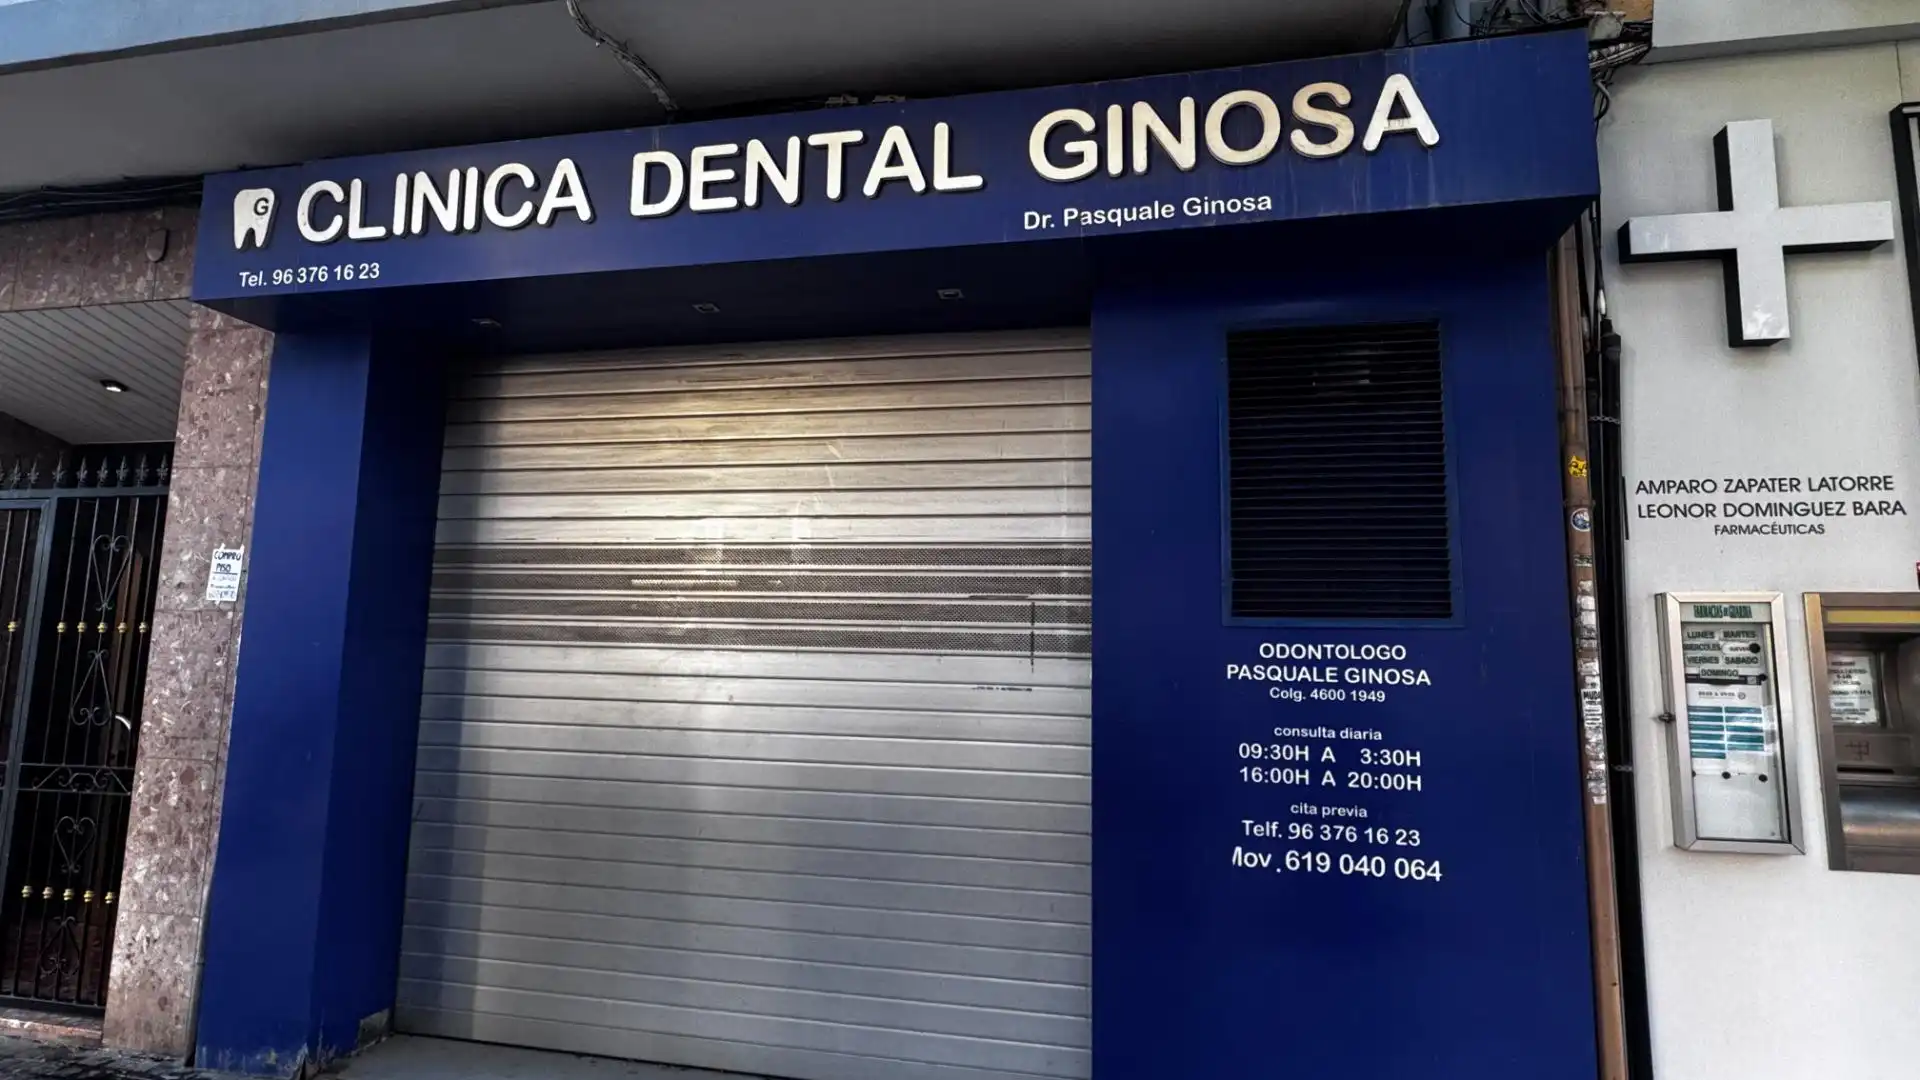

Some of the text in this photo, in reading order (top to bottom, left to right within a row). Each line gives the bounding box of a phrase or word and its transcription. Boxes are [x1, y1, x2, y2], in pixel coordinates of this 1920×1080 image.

[297, 74, 1439, 241] CLINICA DENTAL GINOSA
[253, 198, 269, 216] G
[1025, 196, 1271, 229] Dr. Pasquale Ginosa
[240, 263, 379, 287] Tel. 96 376 16 23
[1636, 476, 1893, 494] AMPARO ZAPATER LATORRE
[1638, 501, 1907, 518] LEONOR DOMINGUEZ BARA
[1715, 522, 1825, 535] FARMACÉUTICAS
[1260, 643, 1406, 660] ODONTOLOGO
[1228, 665, 1431, 685] PASQUALE GINOSA
[1270, 687, 1385, 702] Colg. 4600 1949
[1274, 727, 1382, 740] consulta diaria
[1239, 743, 1420, 766] 09:30H A 3:30H
[1240, 767, 1421, 791] 16:00H A 20:00H
[1291, 803, 1367, 818] cita previa
[1242, 820, 1420, 846] Telf. 96 376 16 23
[1286, 851, 1330, 872] 619
[1340, 854, 1385, 877] 040
[1395, 858, 1442, 881] 064
